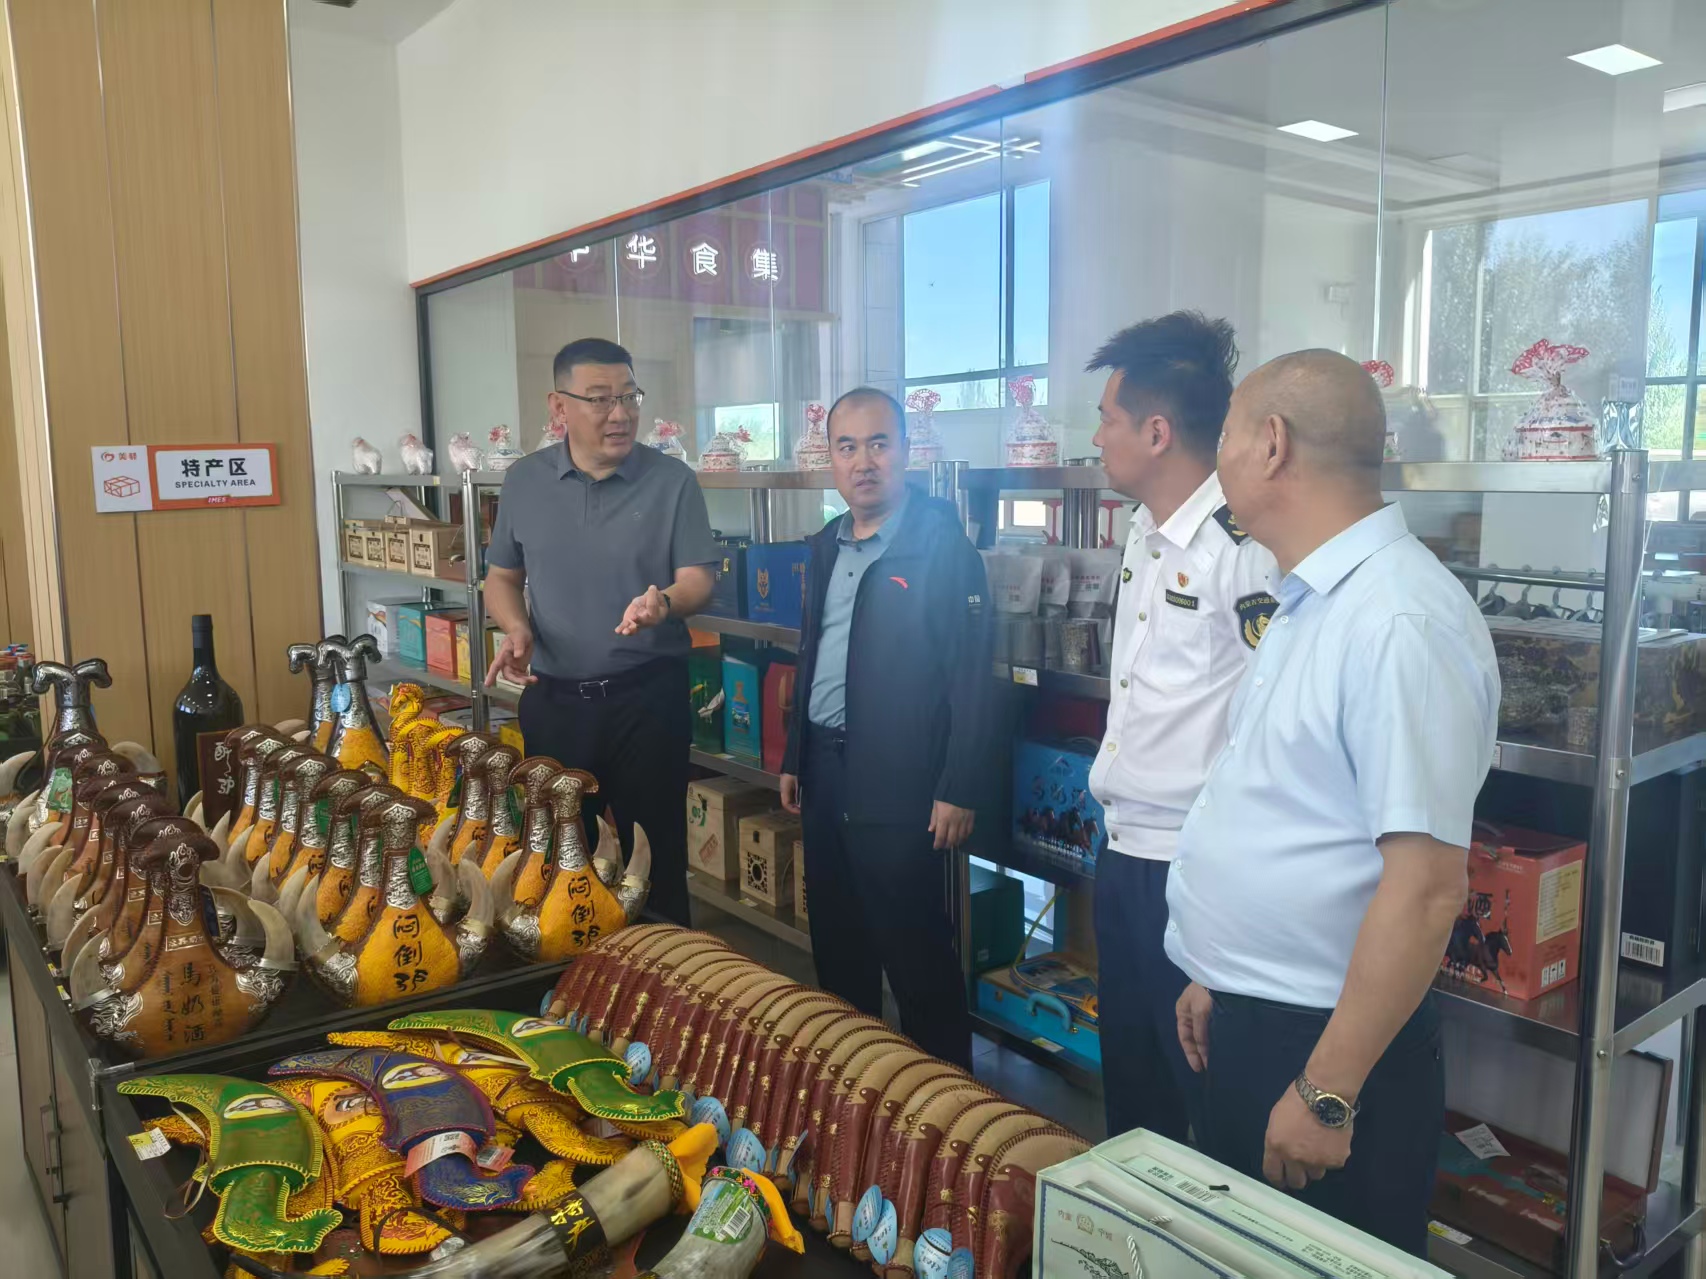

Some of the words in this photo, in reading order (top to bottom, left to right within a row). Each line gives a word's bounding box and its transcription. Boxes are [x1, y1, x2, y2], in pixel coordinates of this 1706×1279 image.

[181, 458, 248, 478] 特产区
[175, 480, 227, 489] SPECIALTY
[230, 479, 256, 487] AREA
[393, 914, 428, 993] 闷倒驴
